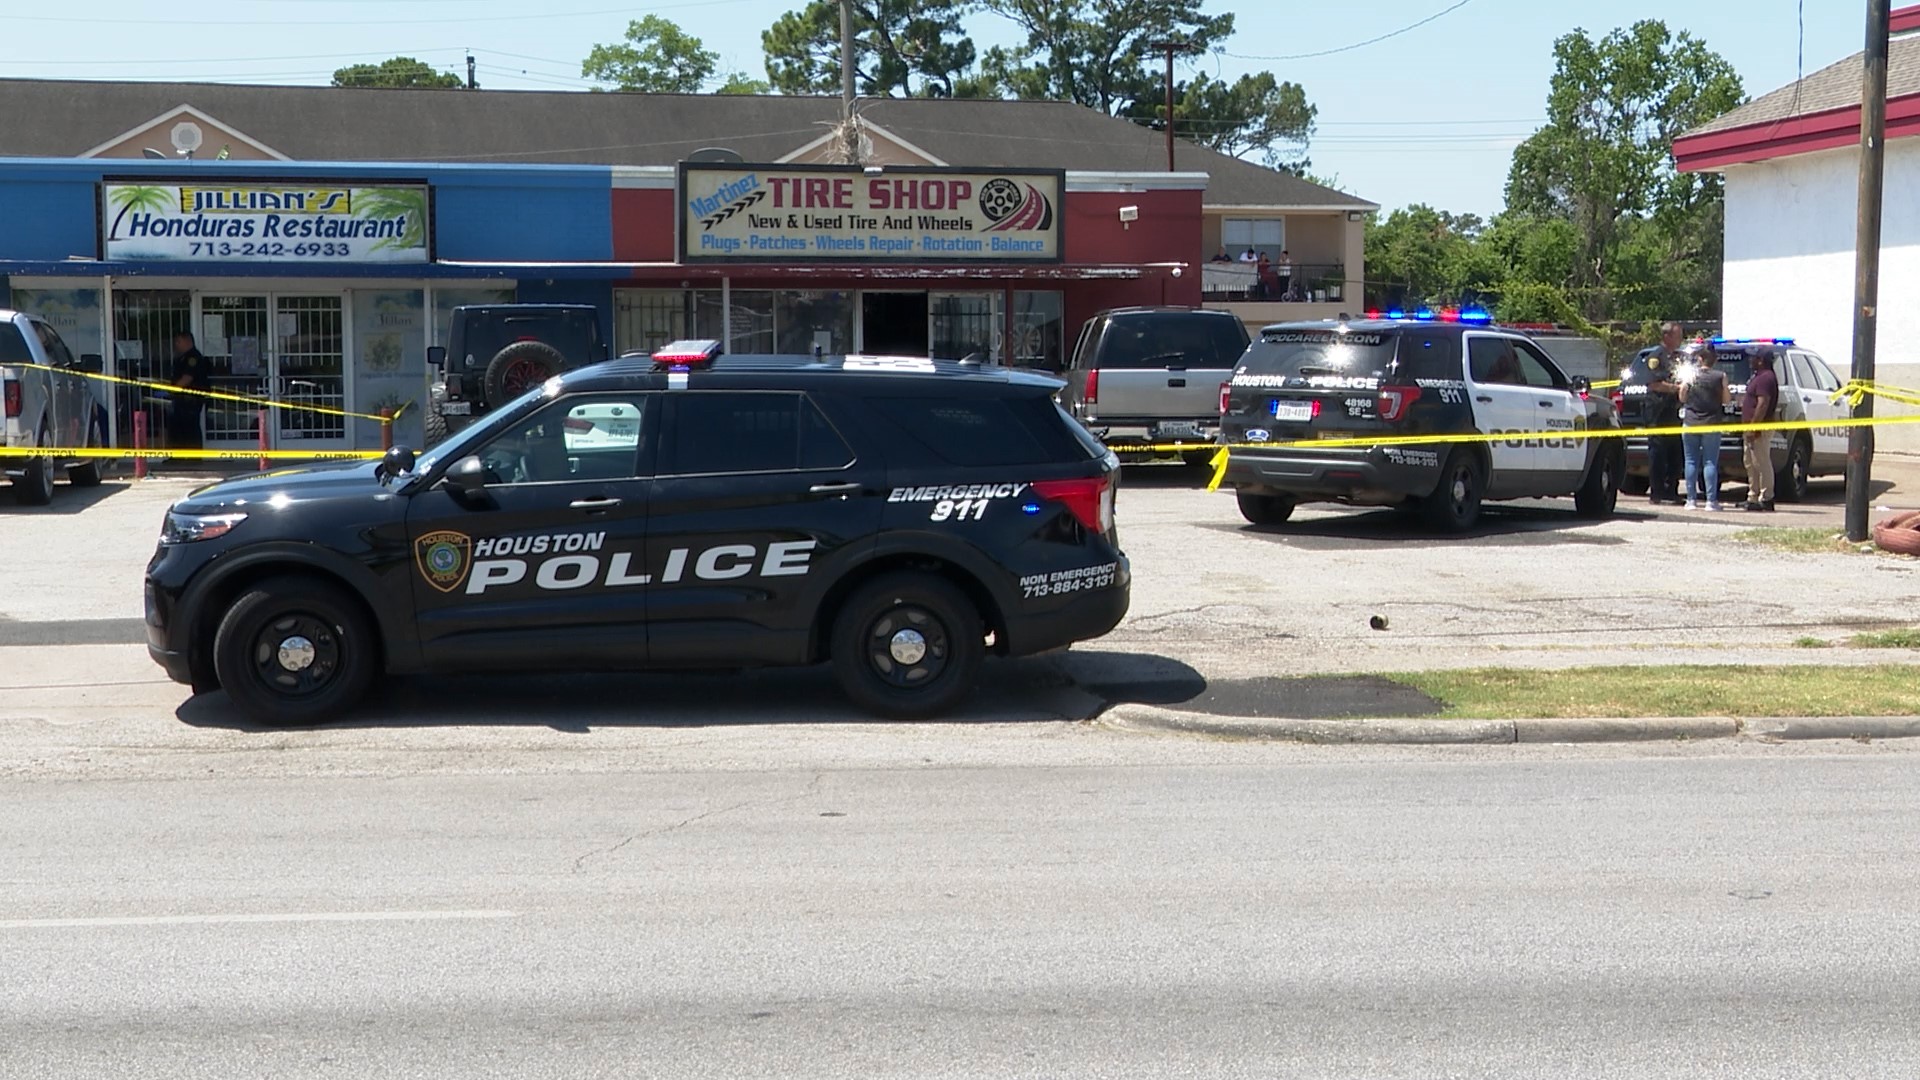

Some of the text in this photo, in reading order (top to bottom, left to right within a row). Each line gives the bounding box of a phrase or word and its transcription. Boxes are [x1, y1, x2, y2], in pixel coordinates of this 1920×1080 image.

[193, 192, 345, 212] JILLIAN'S
[689, 173, 761, 220] Martinez
[766, 178, 972, 210] TIRE SHOP
[129, 212, 406, 239] Honduras Restaurant
[748, 214, 973, 231] New & Used Tire And Wheels
[190, 242, 350, 257] 713-242-6933
[702, 234, 1044, 254] Plugs Patches Wheels Repair Rotation Balance
[1231, 375, 1286, 387] HOUSTON
[1310, 376, 1378, 389] POLICE
[1415, 378, 1467, 390] EMERGENCY
[1344, 398, 1372, 407] 48168
[1438, 389, 1462, 404] 911
[1546, 418, 1573, 428] HOUSTON
[1489, 428, 1576, 449] POLICE
[887, 482, 1029, 502] EMERGENCY
[930, 499, 989, 522] 911
[422, 534, 463, 547] HOUSTON
[474, 531, 606, 557] HOUSTON
[465, 540, 817, 595] POLICE
[1019, 561, 1118, 588] NON EMERGENCY
[1023, 573, 1115, 599] 713-884-3131
